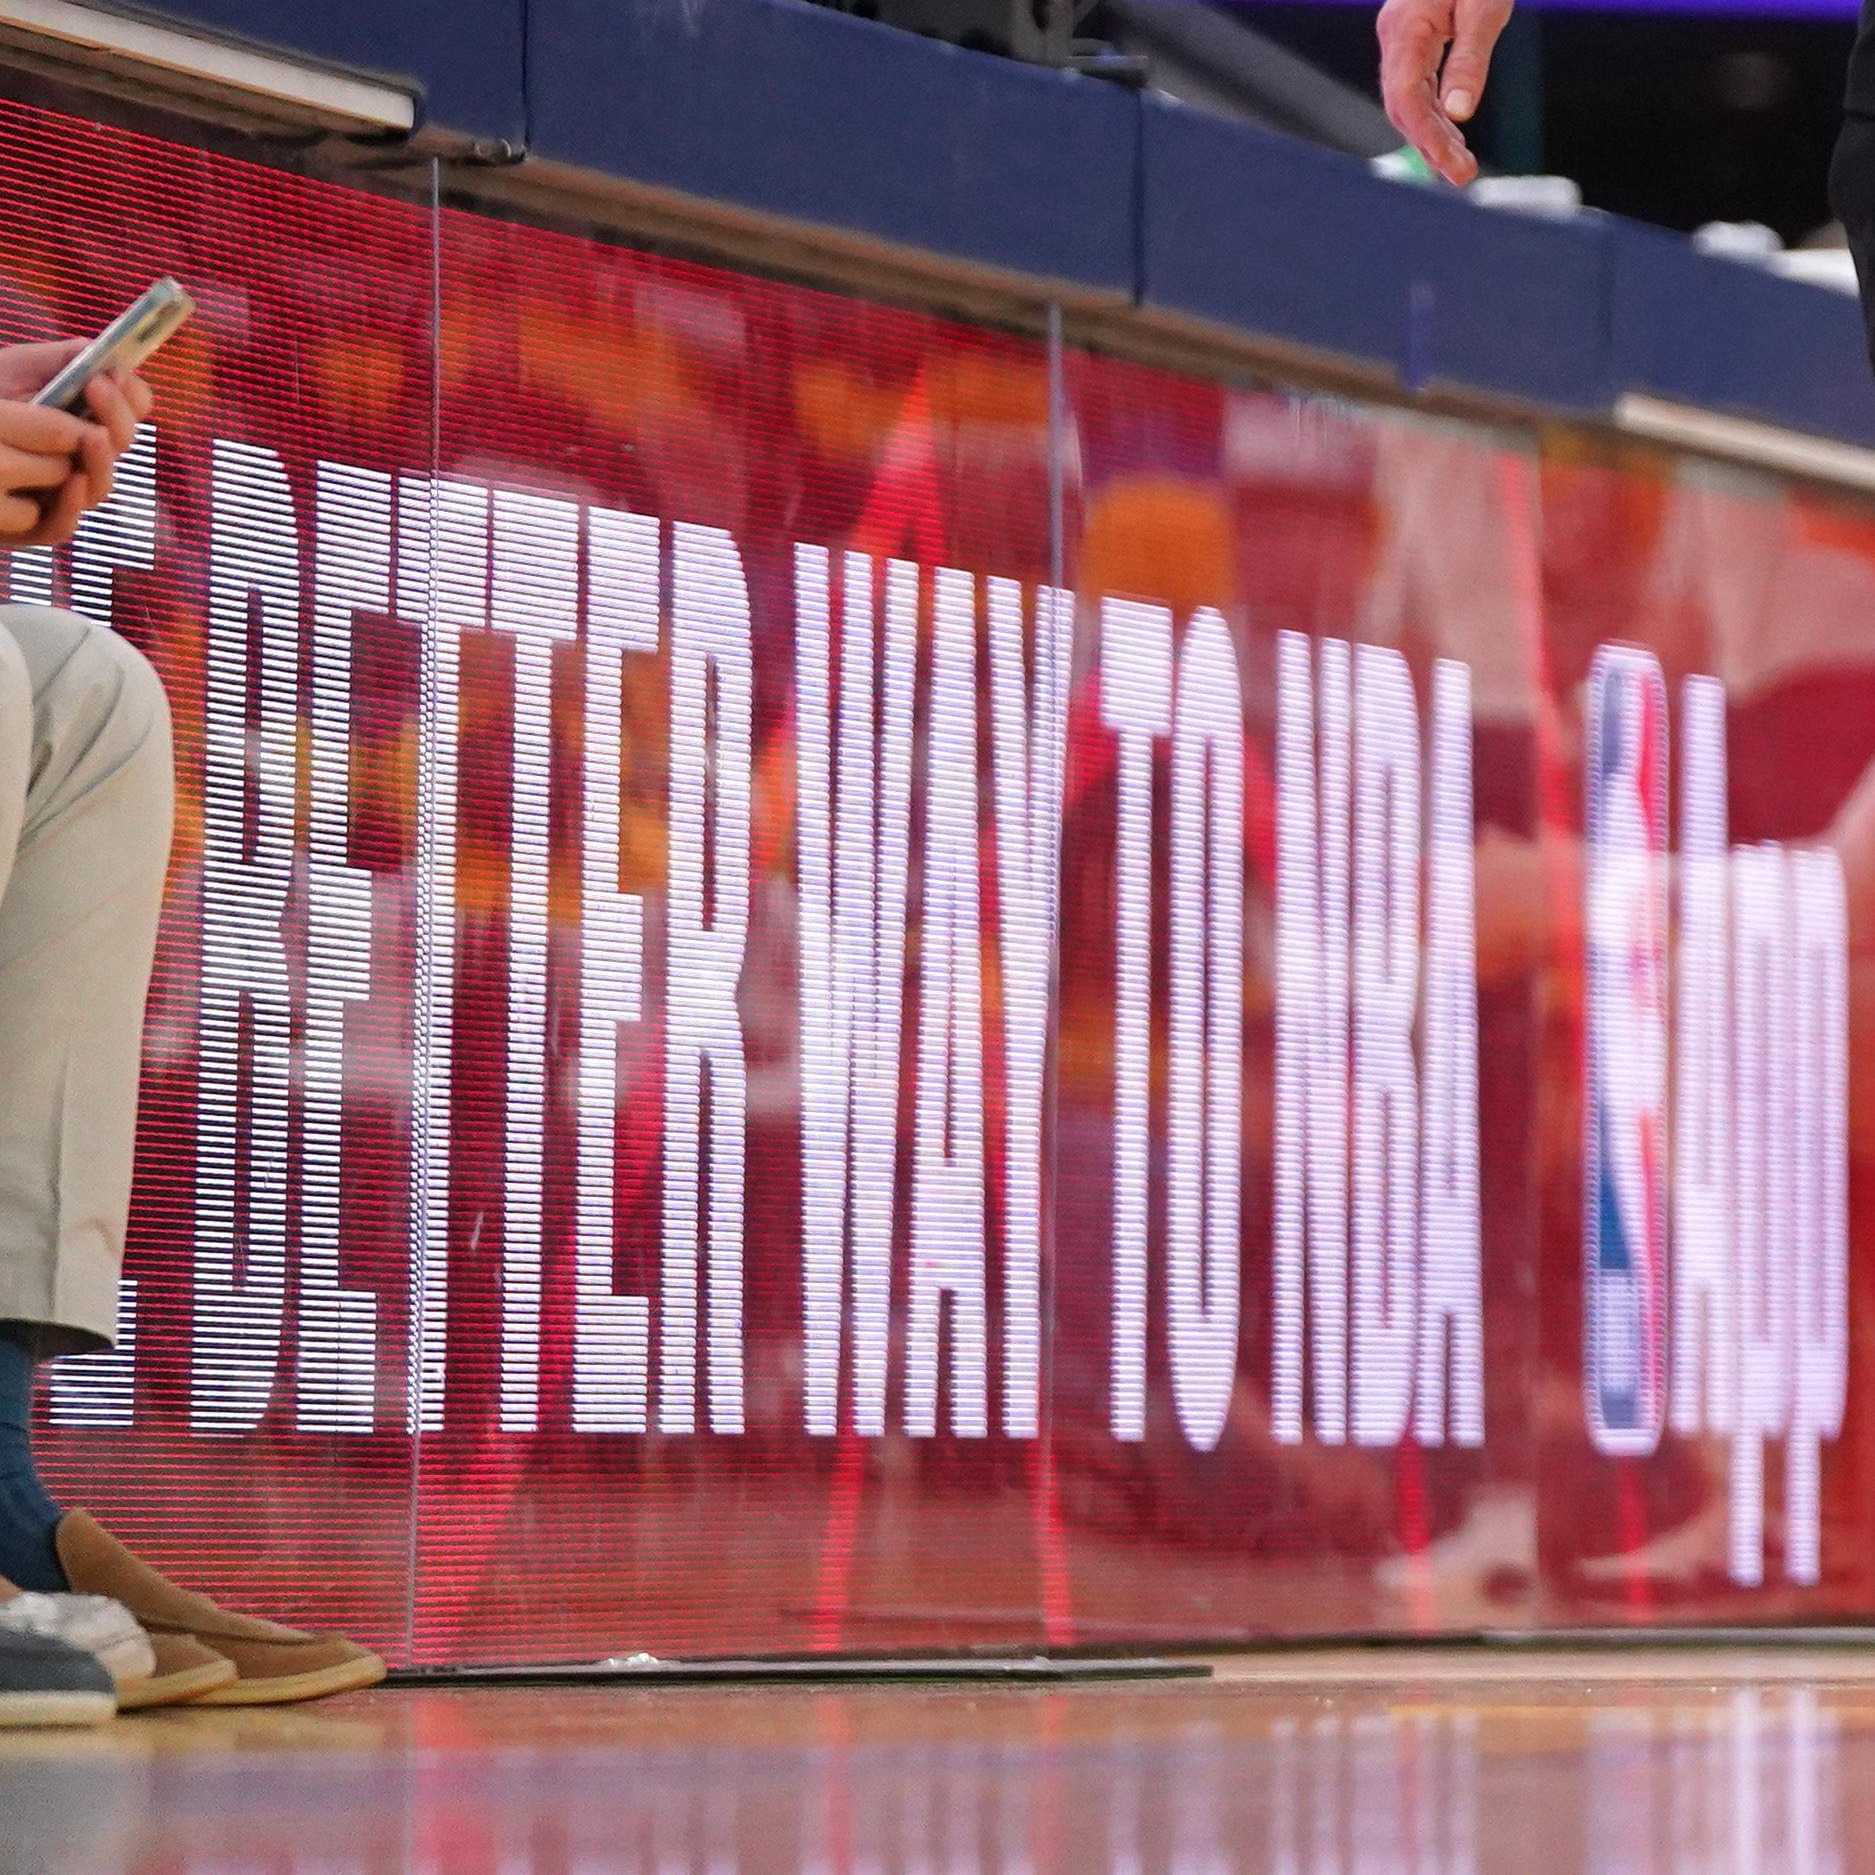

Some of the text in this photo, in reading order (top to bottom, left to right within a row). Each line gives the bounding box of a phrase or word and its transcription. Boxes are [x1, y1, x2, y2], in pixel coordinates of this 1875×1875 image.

[191, 440, 752, 1435] BETTER
[796, 541, 1076, 1438] WAY
[1101, 595, 1245, 1452] TO
[1272, 629, 1485, 1448] NBA
